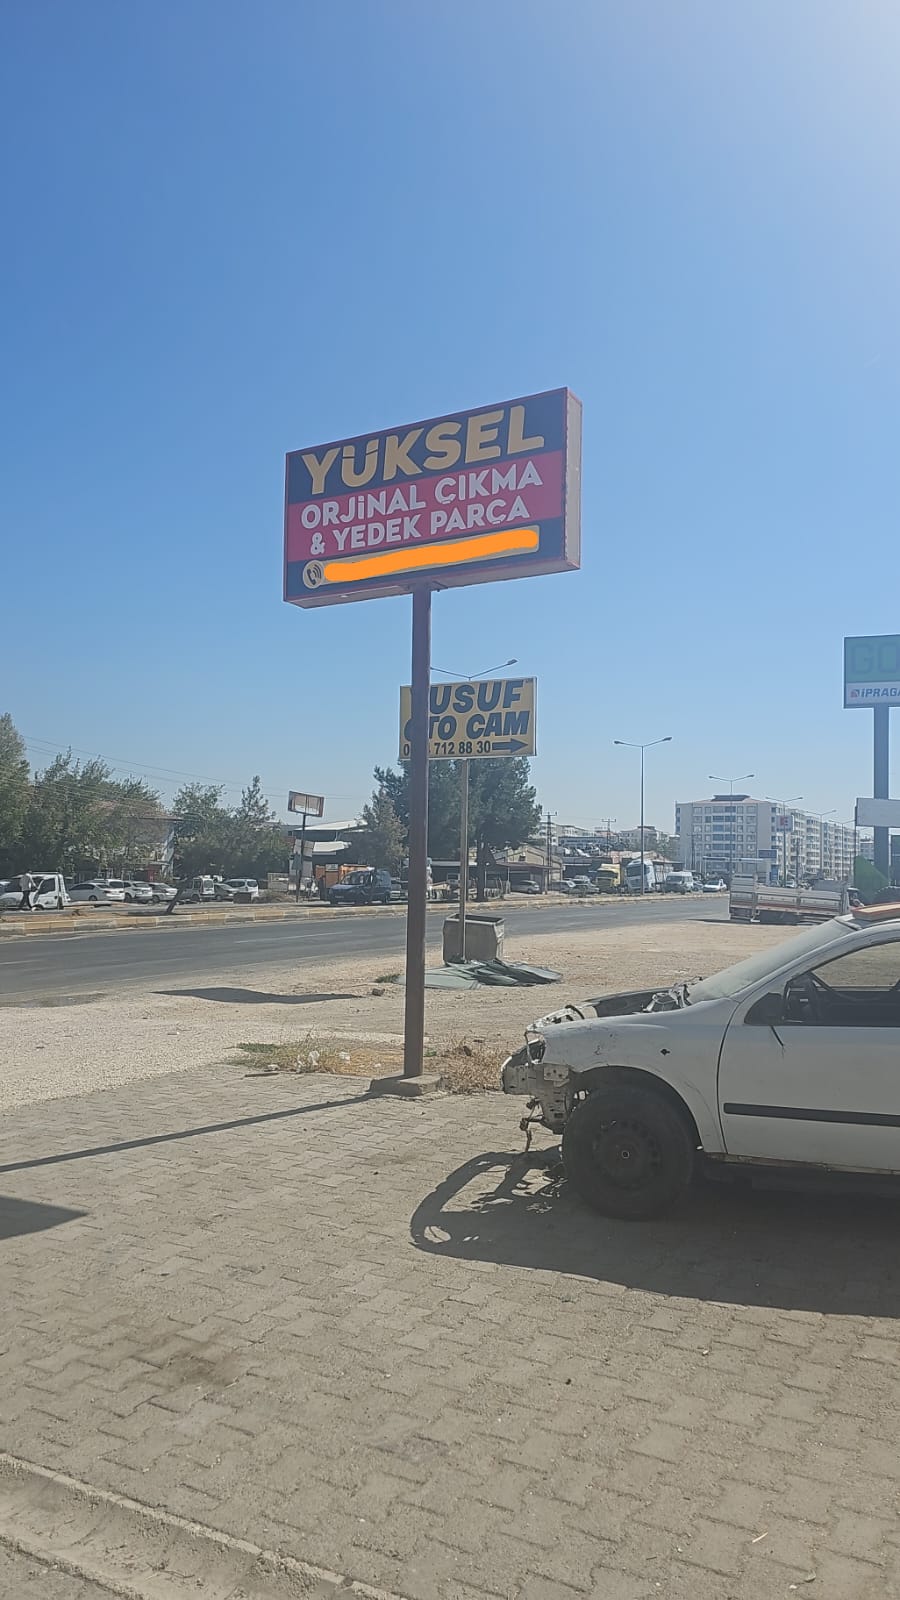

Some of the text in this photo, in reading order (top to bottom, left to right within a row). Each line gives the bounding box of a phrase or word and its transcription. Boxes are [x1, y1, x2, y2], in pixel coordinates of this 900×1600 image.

[301, 405, 544, 495] YÜKSEL
[435, 460, 543, 505] ÇIKMA
[310, 496, 530, 556] & YEDEK PARÇA
[410, 680, 524, 715] USUF
[466, 711, 530, 740] CAM
[434, 741, 455, 755] 712
[458, 741, 473, 754] 88
[476, 740, 491, 754] 30
